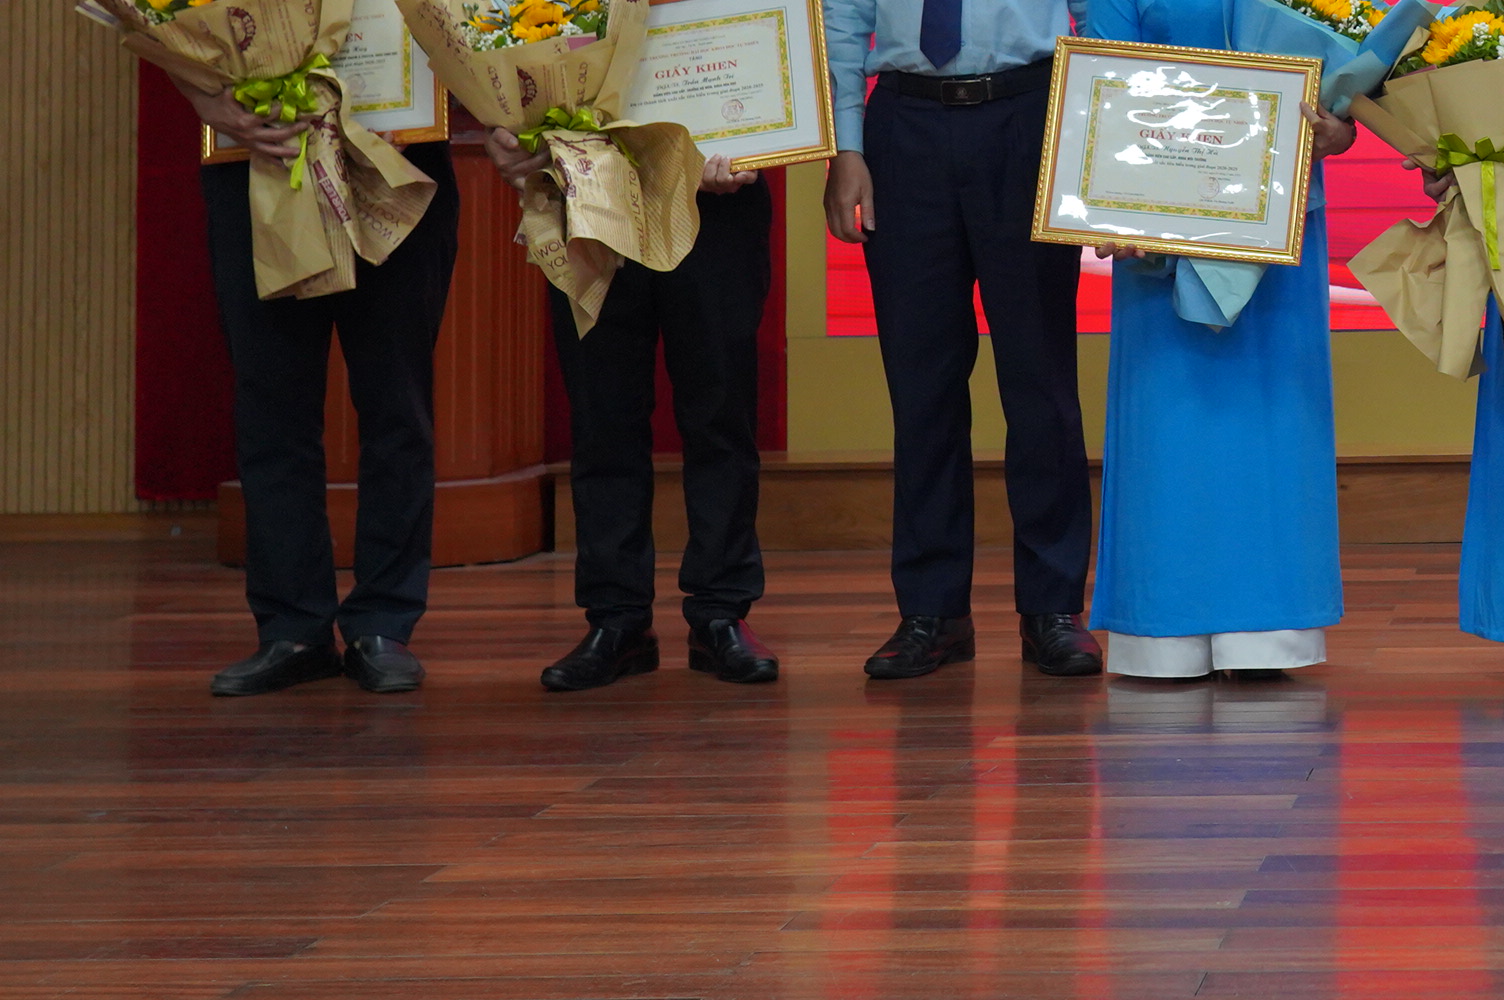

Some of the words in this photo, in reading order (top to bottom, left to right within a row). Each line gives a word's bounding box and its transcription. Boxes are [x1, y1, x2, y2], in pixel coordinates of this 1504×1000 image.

[654, 64, 691, 80] GIẤY
[696, 60, 738, 74] KHEN
[628, 170, 637, 187] TO
